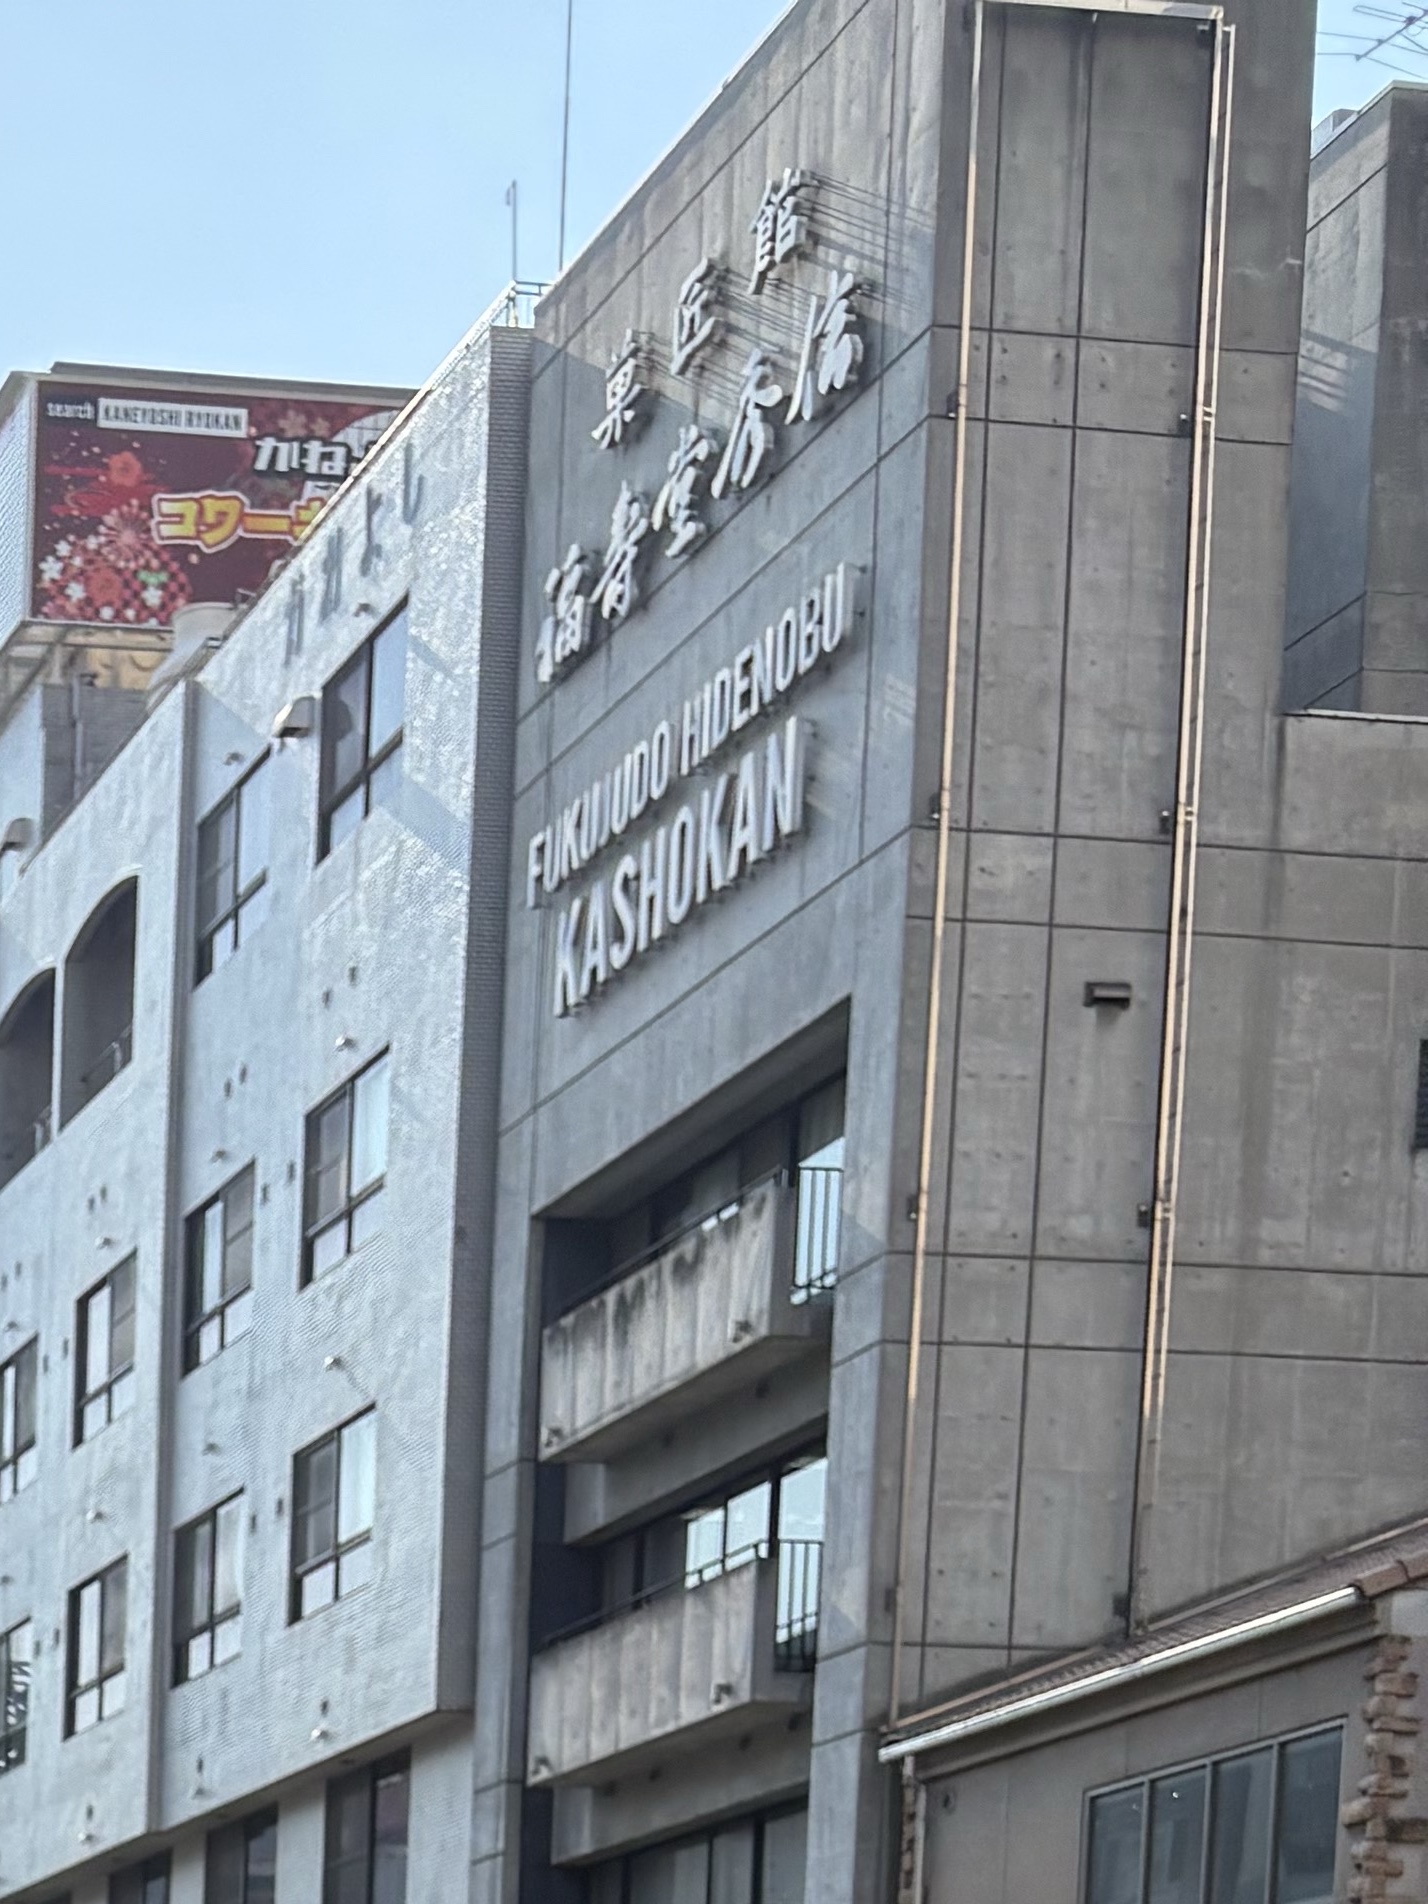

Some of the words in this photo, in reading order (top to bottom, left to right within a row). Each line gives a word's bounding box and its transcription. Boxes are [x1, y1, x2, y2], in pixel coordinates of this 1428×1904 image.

[527, 720, 673, 909] FUKUJUDO
[680, 562, 846, 777] HIDENOBU
[554, 716, 806, 1018] KASHOKAN
